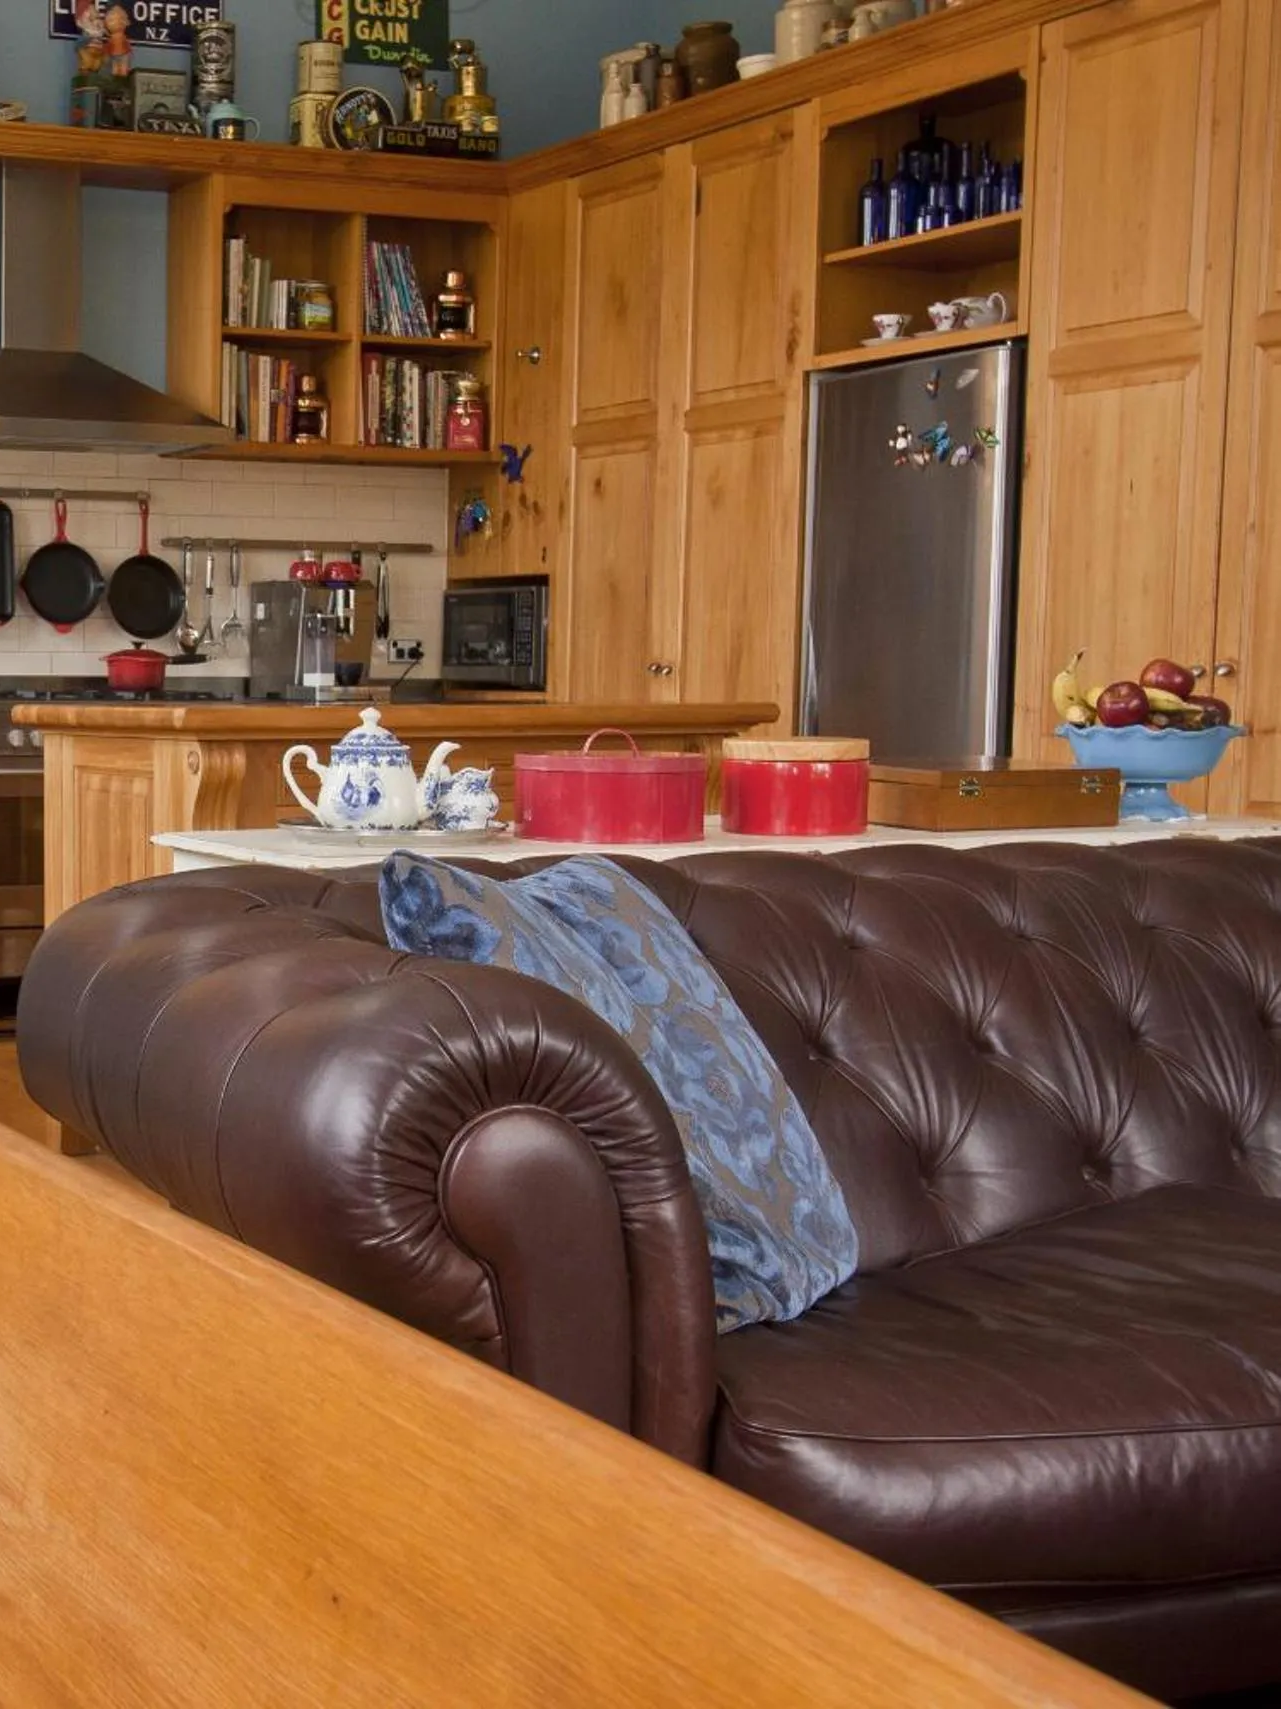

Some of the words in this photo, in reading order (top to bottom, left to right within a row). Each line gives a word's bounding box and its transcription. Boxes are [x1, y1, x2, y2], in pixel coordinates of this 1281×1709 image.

[56, 0, 107, 17] LIE
[133, 1, 218, 25] OFFICE
[355, 20, 409, 43] GAIN
[147, 119, 202, 134] TAXI
